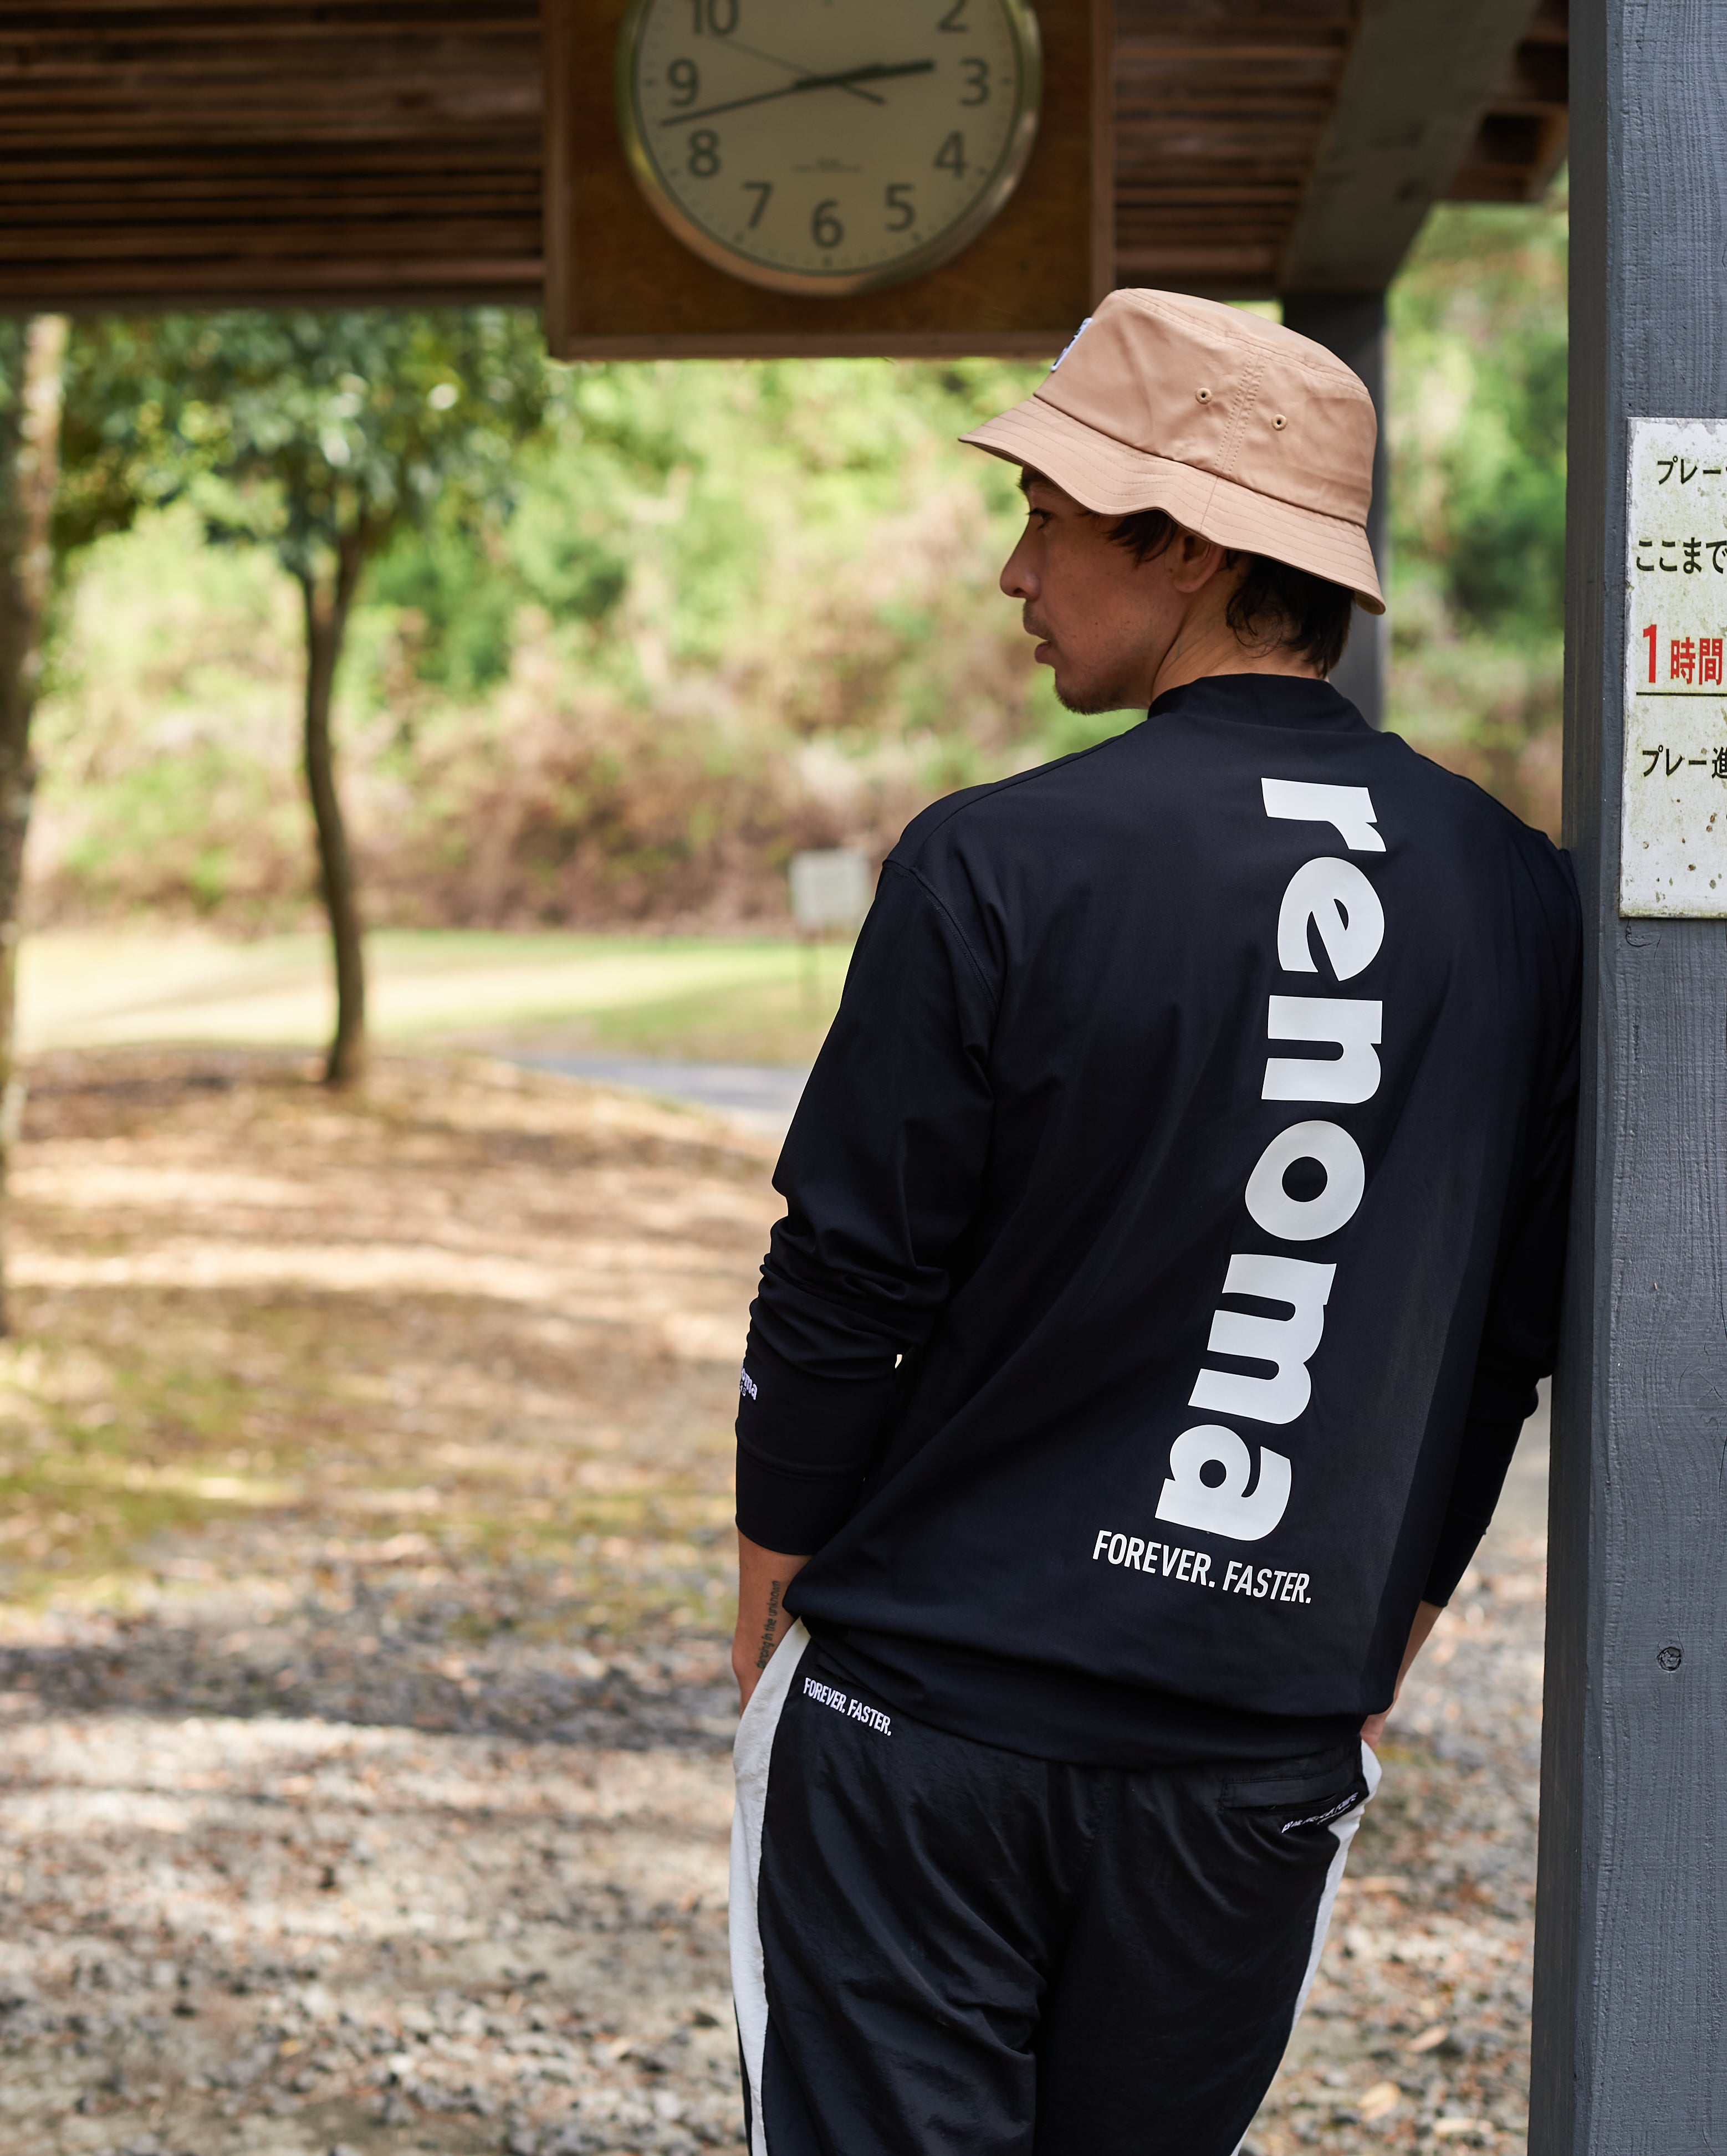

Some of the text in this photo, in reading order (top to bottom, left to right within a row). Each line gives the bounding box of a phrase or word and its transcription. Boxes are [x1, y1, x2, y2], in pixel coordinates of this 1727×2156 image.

[692, 0, 739, 35] 10
[937, 0, 970, 32] 2
[667, 58, 699, 107] 9
[959, 57, 990, 107] 3
[687, 129, 721, 178] 8
[934, 131, 969, 179] 4
[743, 181, 774, 229] 7
[811, 199, 844, 249] 6
[886, 182, 917, 232] 5
[1657, 455, 1727, 485] プレー
[1636, 537, 1727, 574] ここまで
[1643, 624, 1723, 685] 1時間
[1155, 777, 1386, 1540] renoma
[1092, 1529, 1312, 1604] FOREVER. FASTER.
[767, 1581, 781, 1617] unknown
[763, 1617, 776, 1632] the
[803, 1677, 892, 1736] FOREVER. FASTER.
